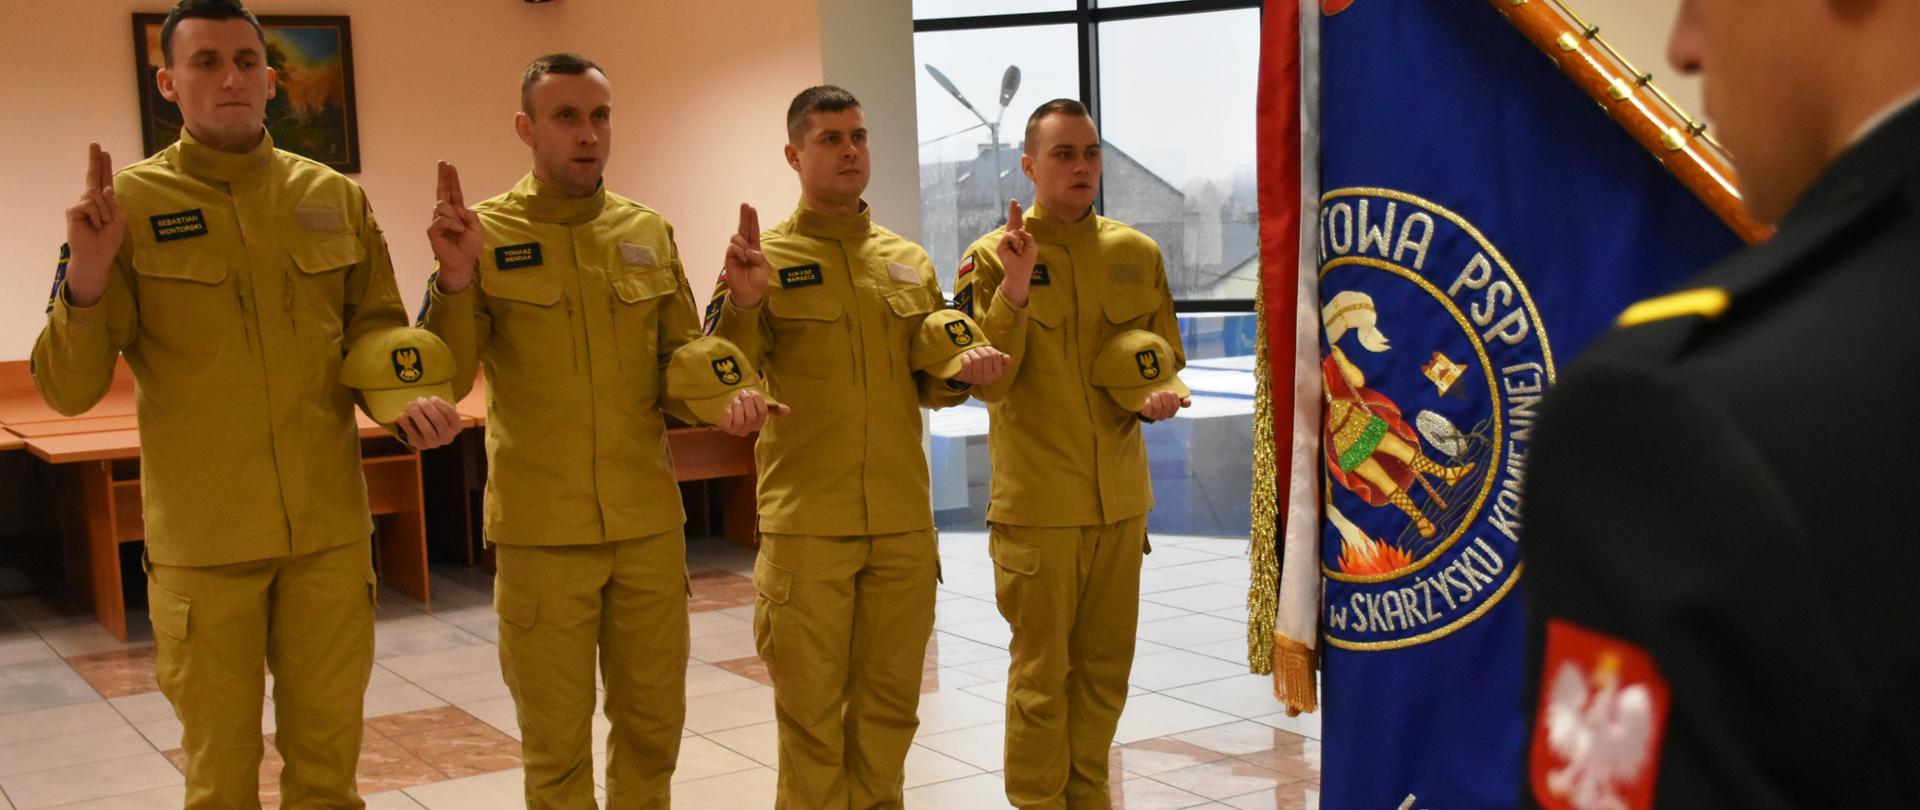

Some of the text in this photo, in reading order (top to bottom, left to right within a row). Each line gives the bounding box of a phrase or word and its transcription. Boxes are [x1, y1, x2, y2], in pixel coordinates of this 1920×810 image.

[157, 215, 198, 227] SEBASTIAN
[503, 248, 532, 256] TOMASZ
[1447, 252, 1529, 345] PSP
[1351, 537, 1504, 633] SKARŻYSKU
